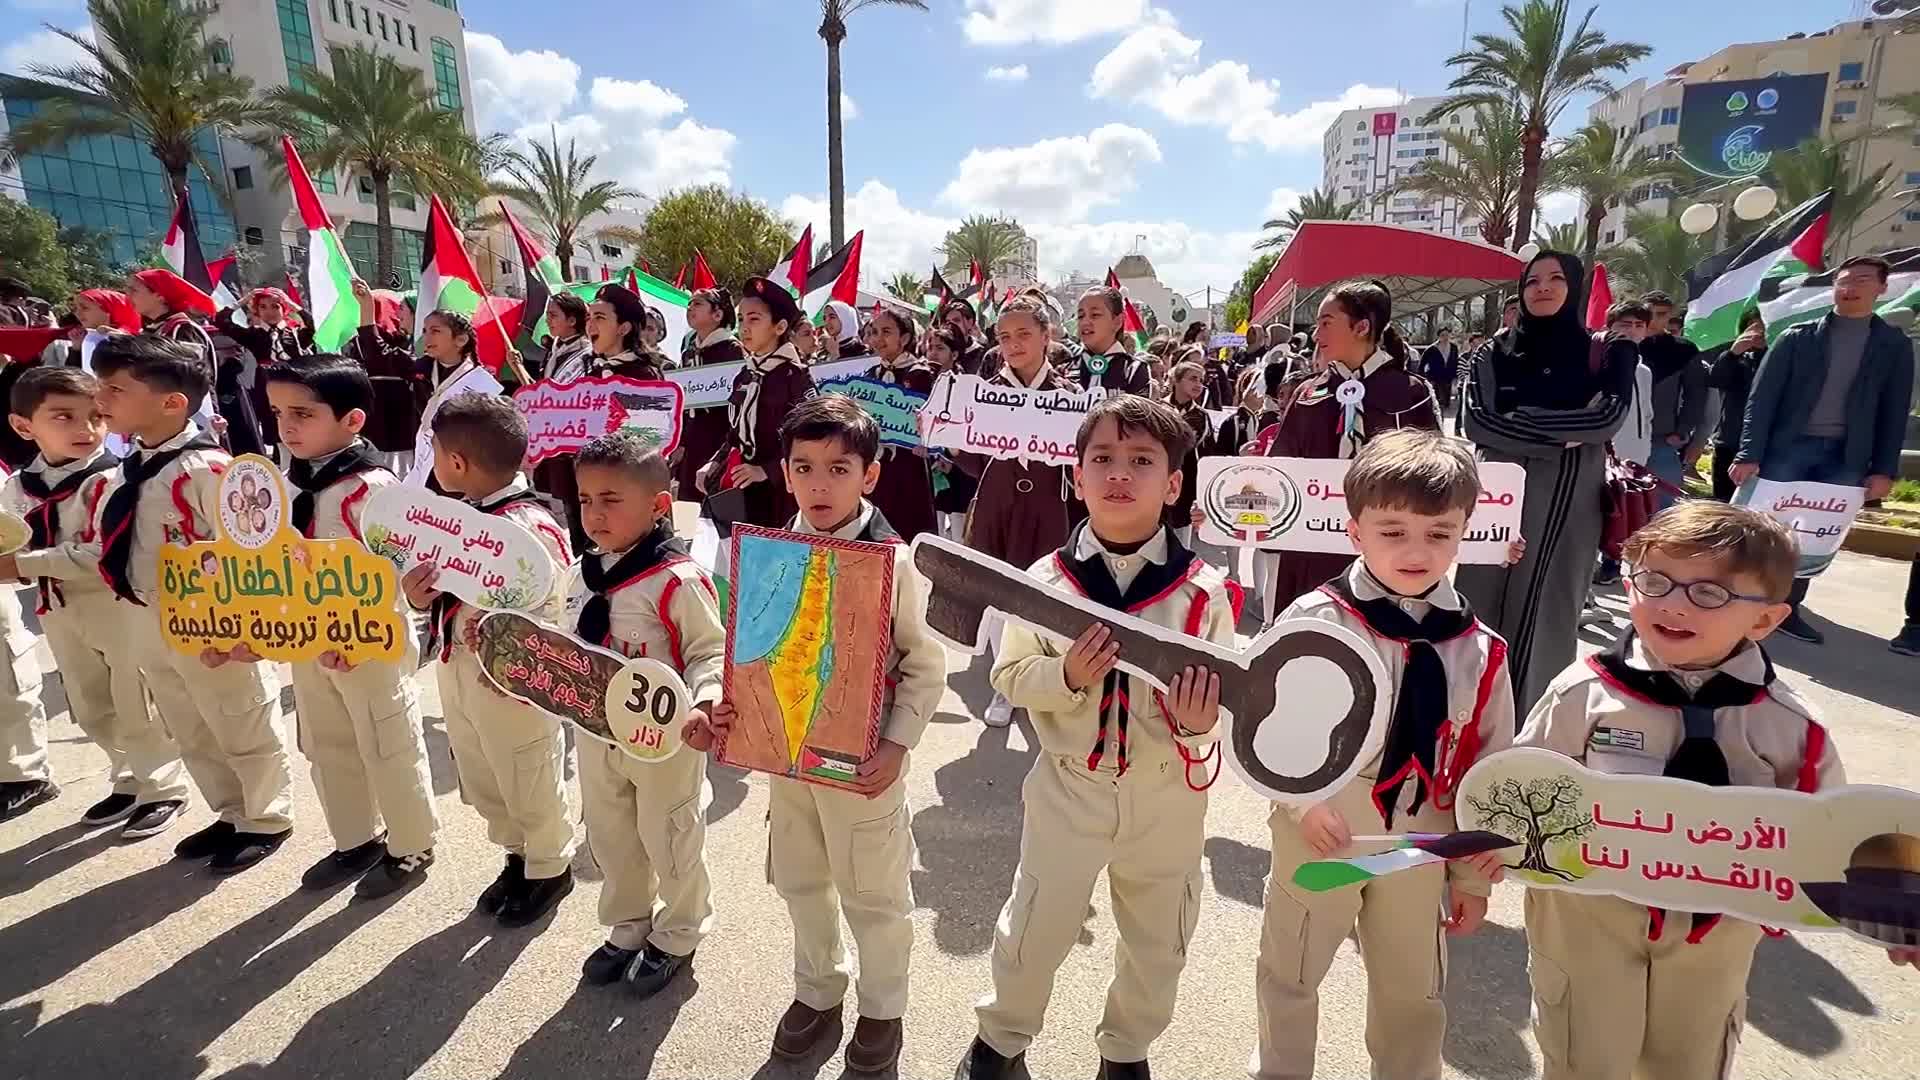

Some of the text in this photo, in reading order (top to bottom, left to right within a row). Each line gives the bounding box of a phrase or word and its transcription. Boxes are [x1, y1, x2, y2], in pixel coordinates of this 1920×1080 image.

[519, 391, 607, 415] #فلسطين
[974, 383, 1028, 411] تجمعنا
[966, 424, 1077, 459] عودة موعدنا
[1306, 479, 1514, 506] مد رة
[1773, 493, 1848, 513] فلسطين
[383, 529, 417, 553] البحر
[406, 505, 505, 557] وطني فلسطين
[1306, 516, 1511, 542] الأس بنات
[164, 543, 384, 607] رياض أطفال غزة
[441, 556, 482, 578] النهر
[482, 570, 505, 588] من
[168, 606, 394, 651] رعاية تربوية تعليمية
[505, 660, 553, 692] الأرض
[624, 672, 677, 726] 30
[629, 725, 665, 750] آذار
[1593, 802, 1787, 851] الأرض لنا
[1580, 842, 1796, 902] والقدس لنا
